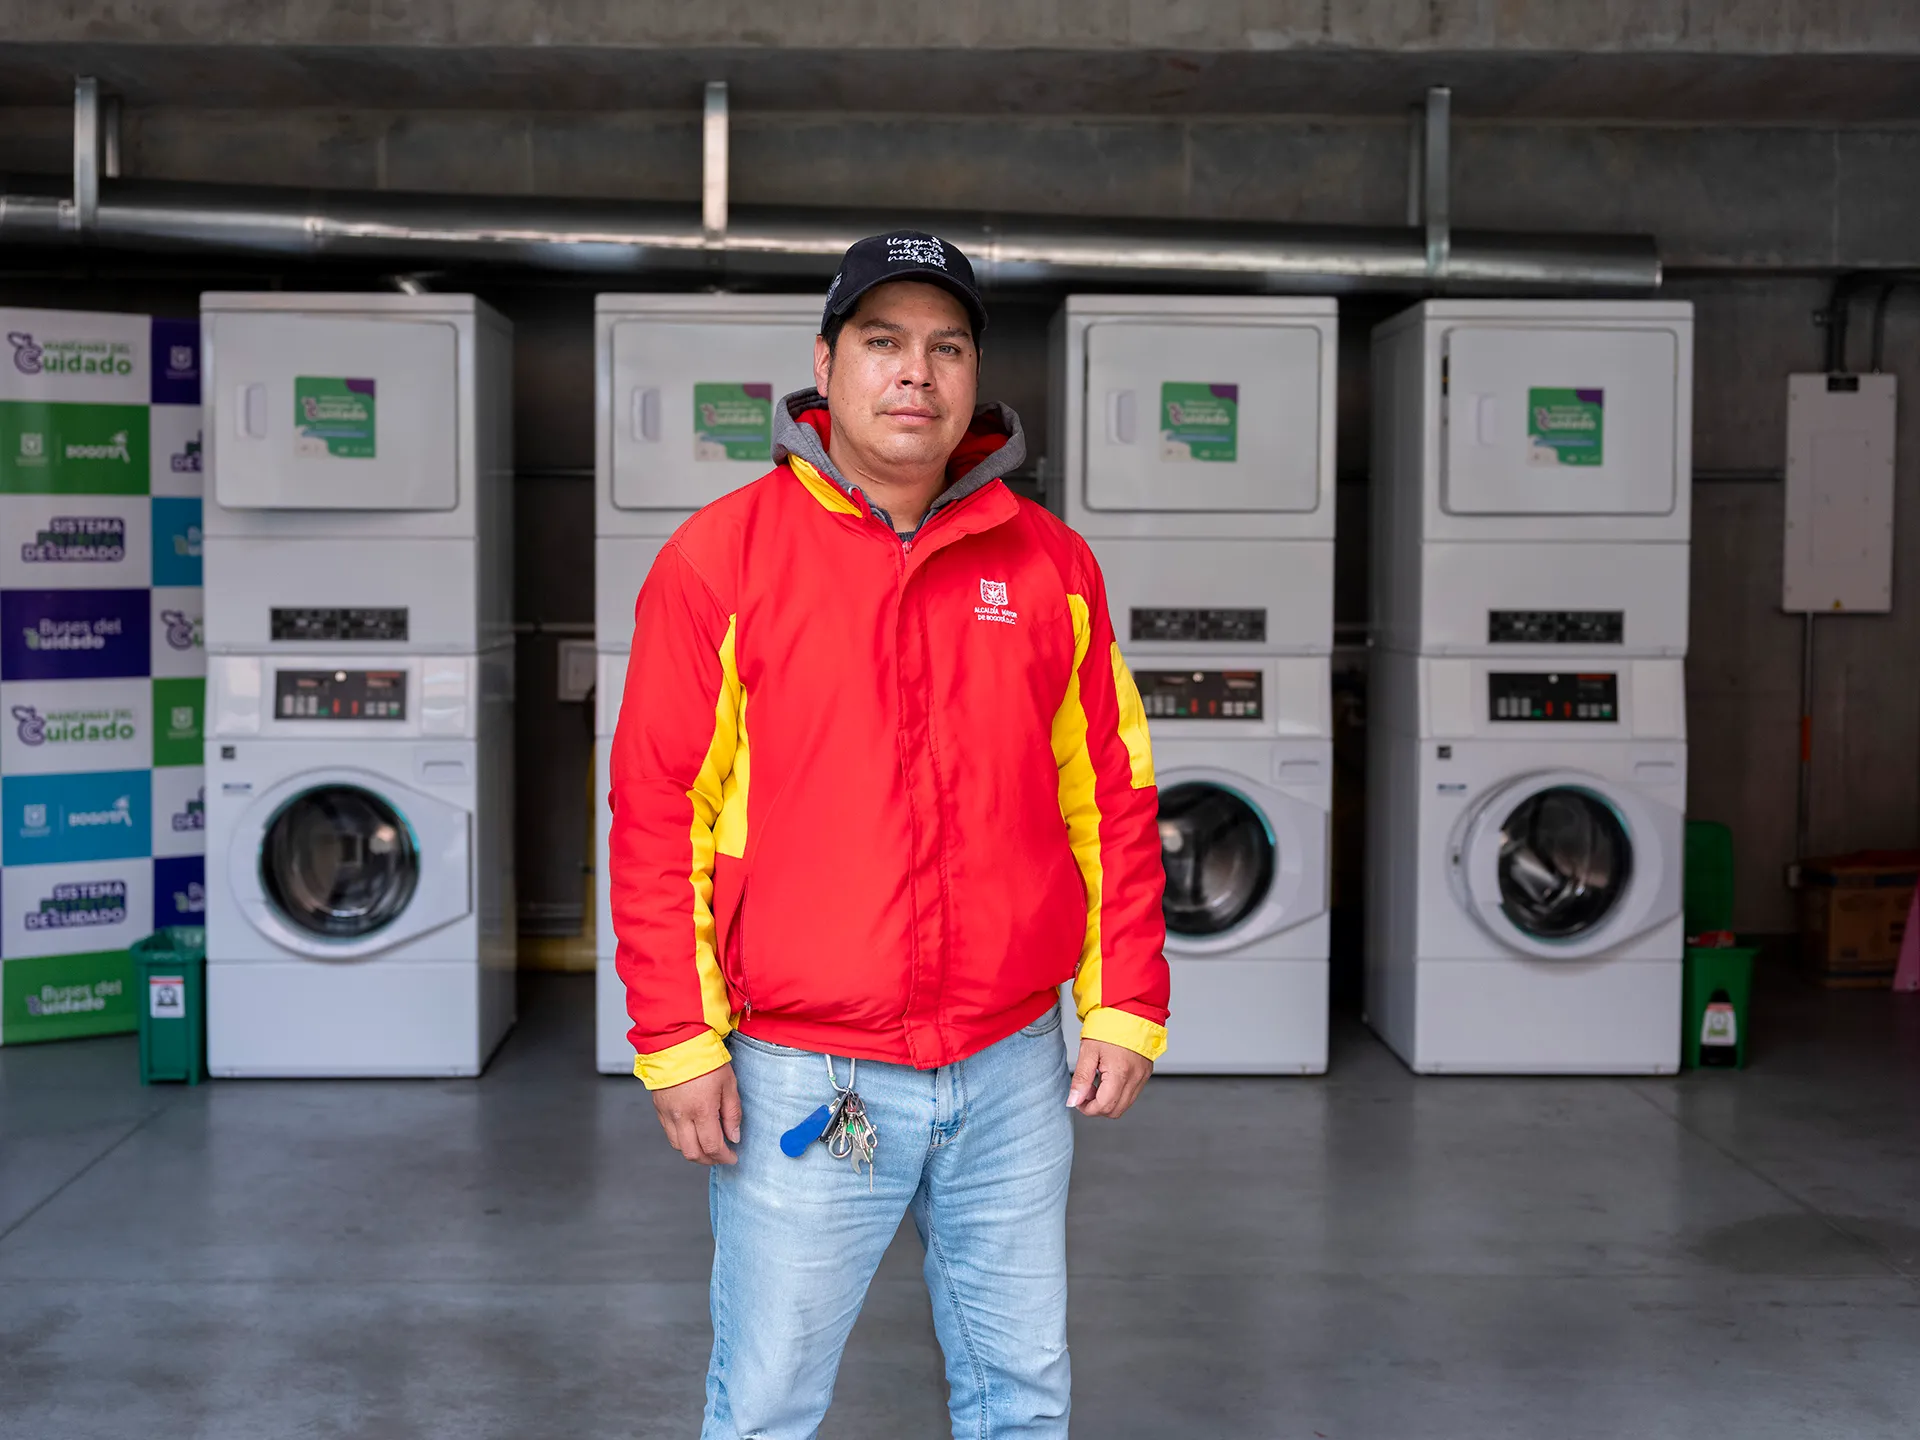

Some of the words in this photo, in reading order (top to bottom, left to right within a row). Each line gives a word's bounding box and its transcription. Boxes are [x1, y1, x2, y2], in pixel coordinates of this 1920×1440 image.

[53, 520, 122, 533] SISTEMA
[93, 619, 122, 635] del
[55, 882, 124, 900] SISTEMA
[95, 980, 122, 996] del
